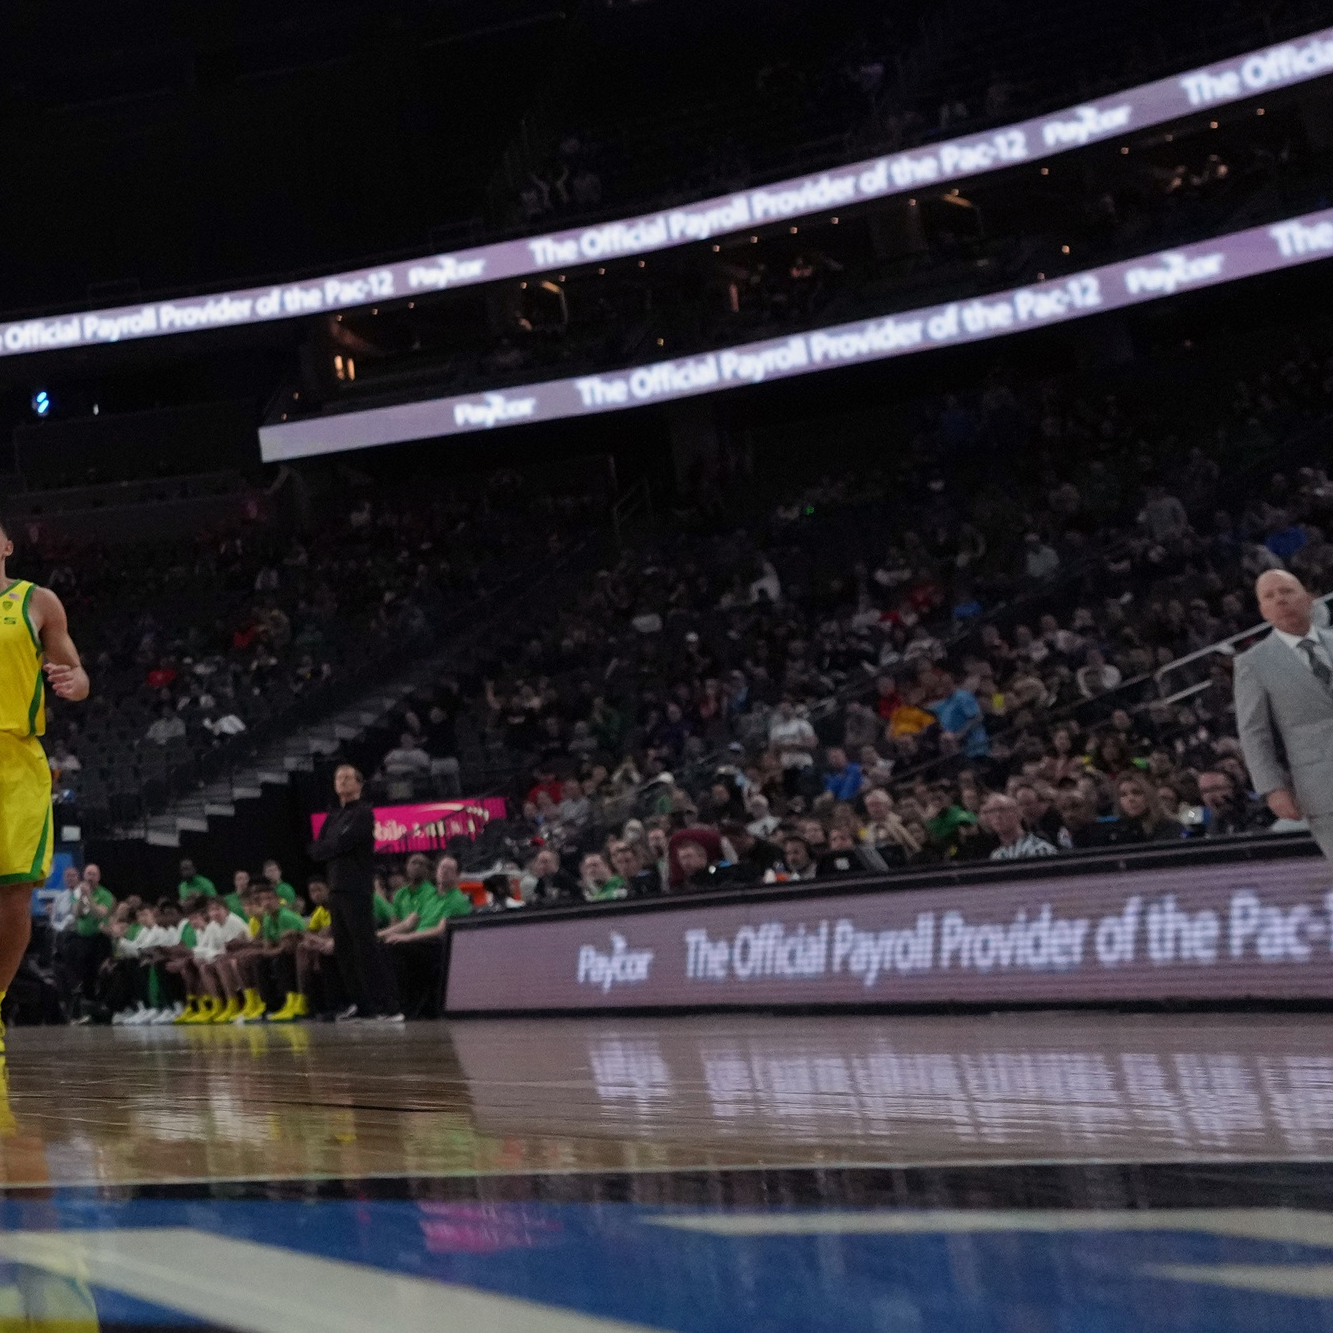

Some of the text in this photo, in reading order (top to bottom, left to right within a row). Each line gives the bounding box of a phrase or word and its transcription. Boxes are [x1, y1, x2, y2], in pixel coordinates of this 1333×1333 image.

[1183, 70, 1240, 107] The
[529, 130, 1028, 267] The Official Payroll Provider of the Pac-12
[5, 315, 80, 352] Official
[84, 306, 157, 343] Payroll
[160, 296, 252, 332] Provider
[257, 287, 281, 317] of
[283, 282, 321, 314] the
[324, 271, 394, 309] Pac-12
[577, 273, 1101, 408] The Official Payroll Provider of the Pac-12
[577, 931, 653, 994] Paycor
[686, 929, 730, 979] The
[732, 918, 827, 978] Official
[831, 912, 933, 987] Payroll
[940, 902, 1091, 970] Provider
[1095, 894, 1144, 964] of
[1146, 892, 1221, 965] the
